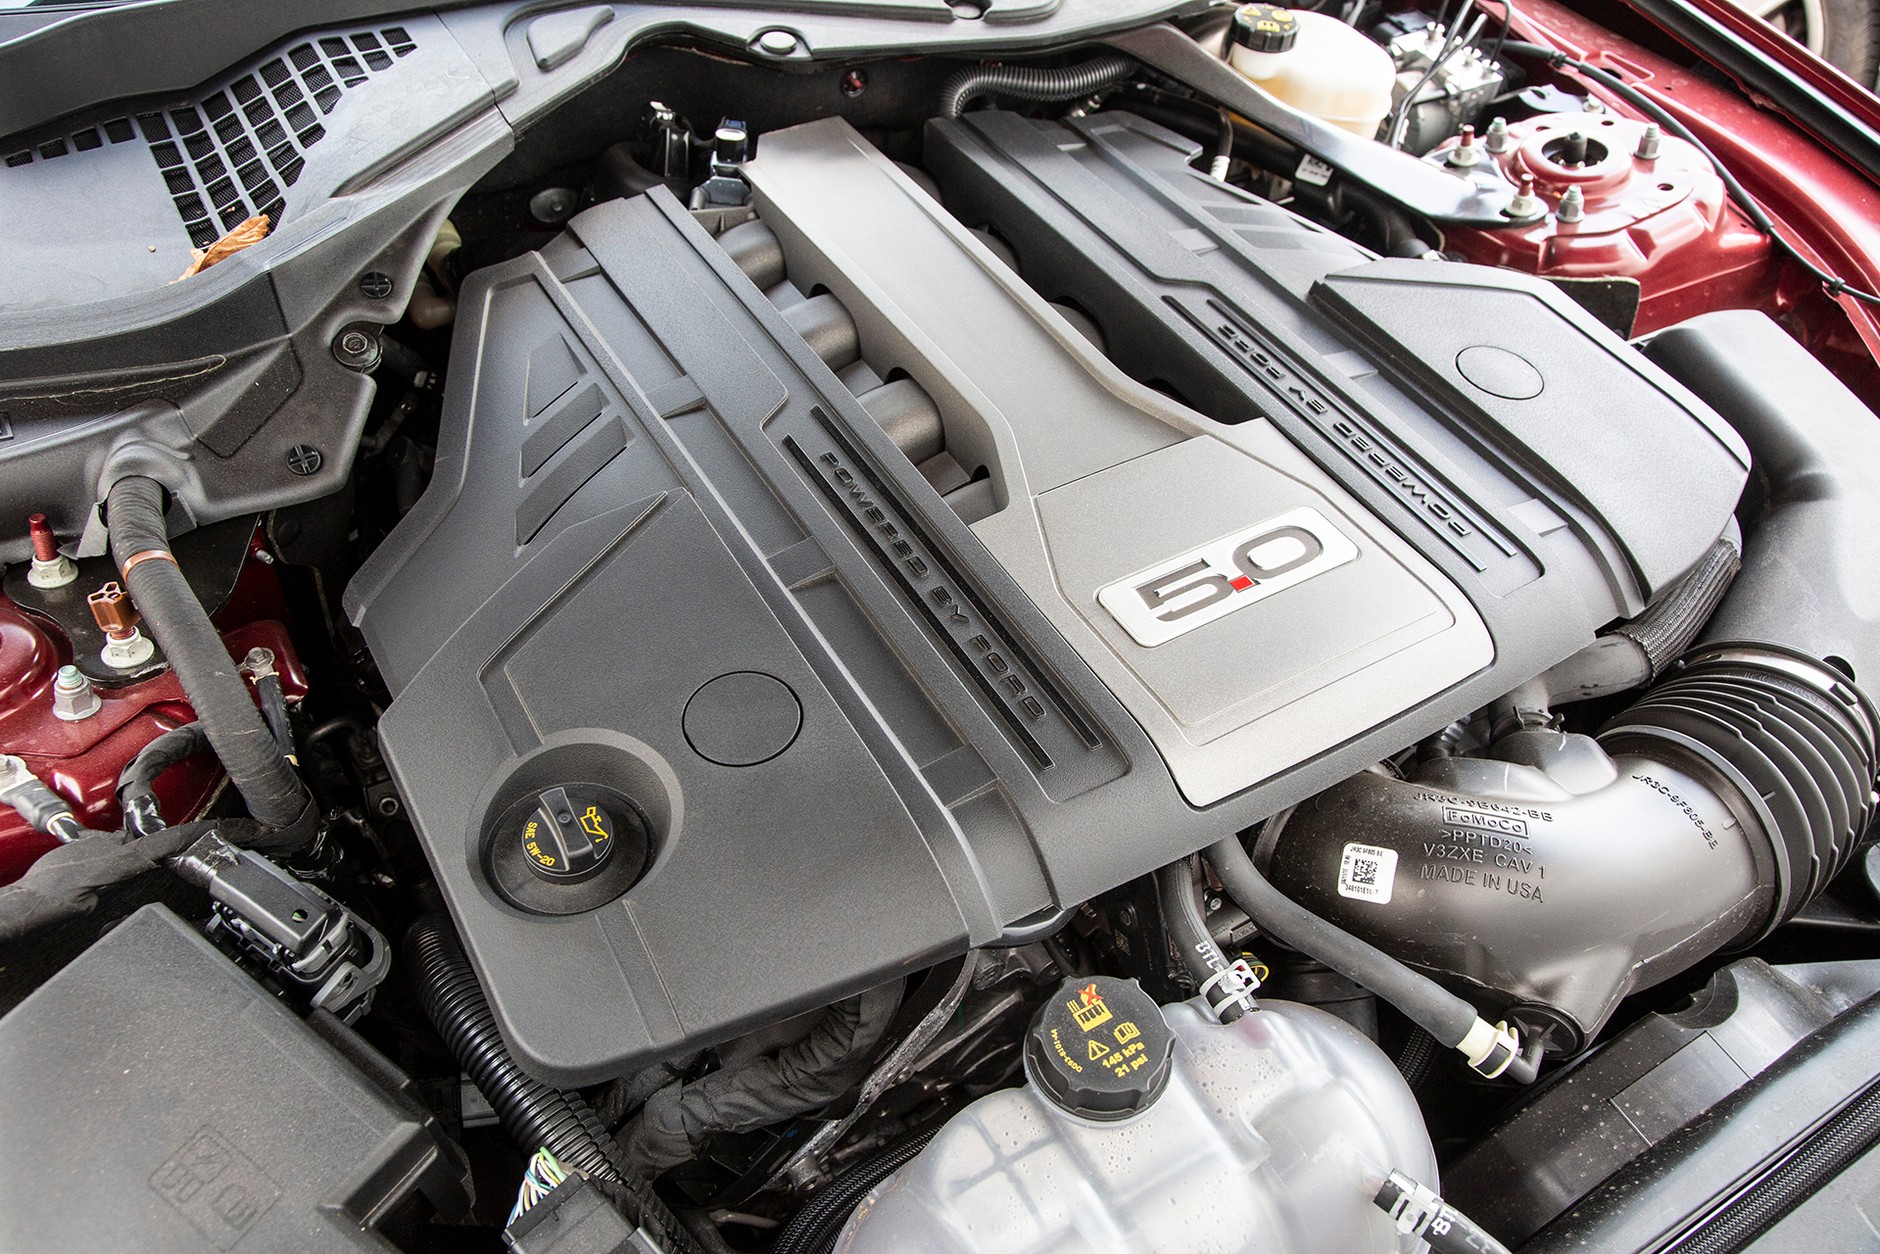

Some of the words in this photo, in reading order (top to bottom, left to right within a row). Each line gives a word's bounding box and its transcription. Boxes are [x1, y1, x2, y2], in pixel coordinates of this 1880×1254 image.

[1217, 323, 1286, 379] FORD
[1289, 386, 1328, 415] BY
[1333, 420, 1472, 537] POWERED
[820, 451, 930, 577] POWERED
[930, 585, 971, 625] BY
[968, 633, 1047, 720] FORD
[1132, 524, 1324, 622] 5.0
[524, 821, 538, 839] SAE
[1447, 809, 1523, 833] FoMoCo
[526, 841, 556, 867] 5W-20
[1423, 842, 1484, 864] V3ZXE
[1494, 853, 1534, 875] CAV
[1538, 864, 1546, 880] 1
[1419, 863, 1478, 886] MADE
[1482, 872, 1502, 891] IN
[1506, 877, 1544, 904] USA
[1101, 1051, 1124, 1069] 145
[1121, 1041, 1146, 1058] kPa
[1114, 1063, 1131, 1078] 21
[1130, 1053, 1149, 1071] psi
